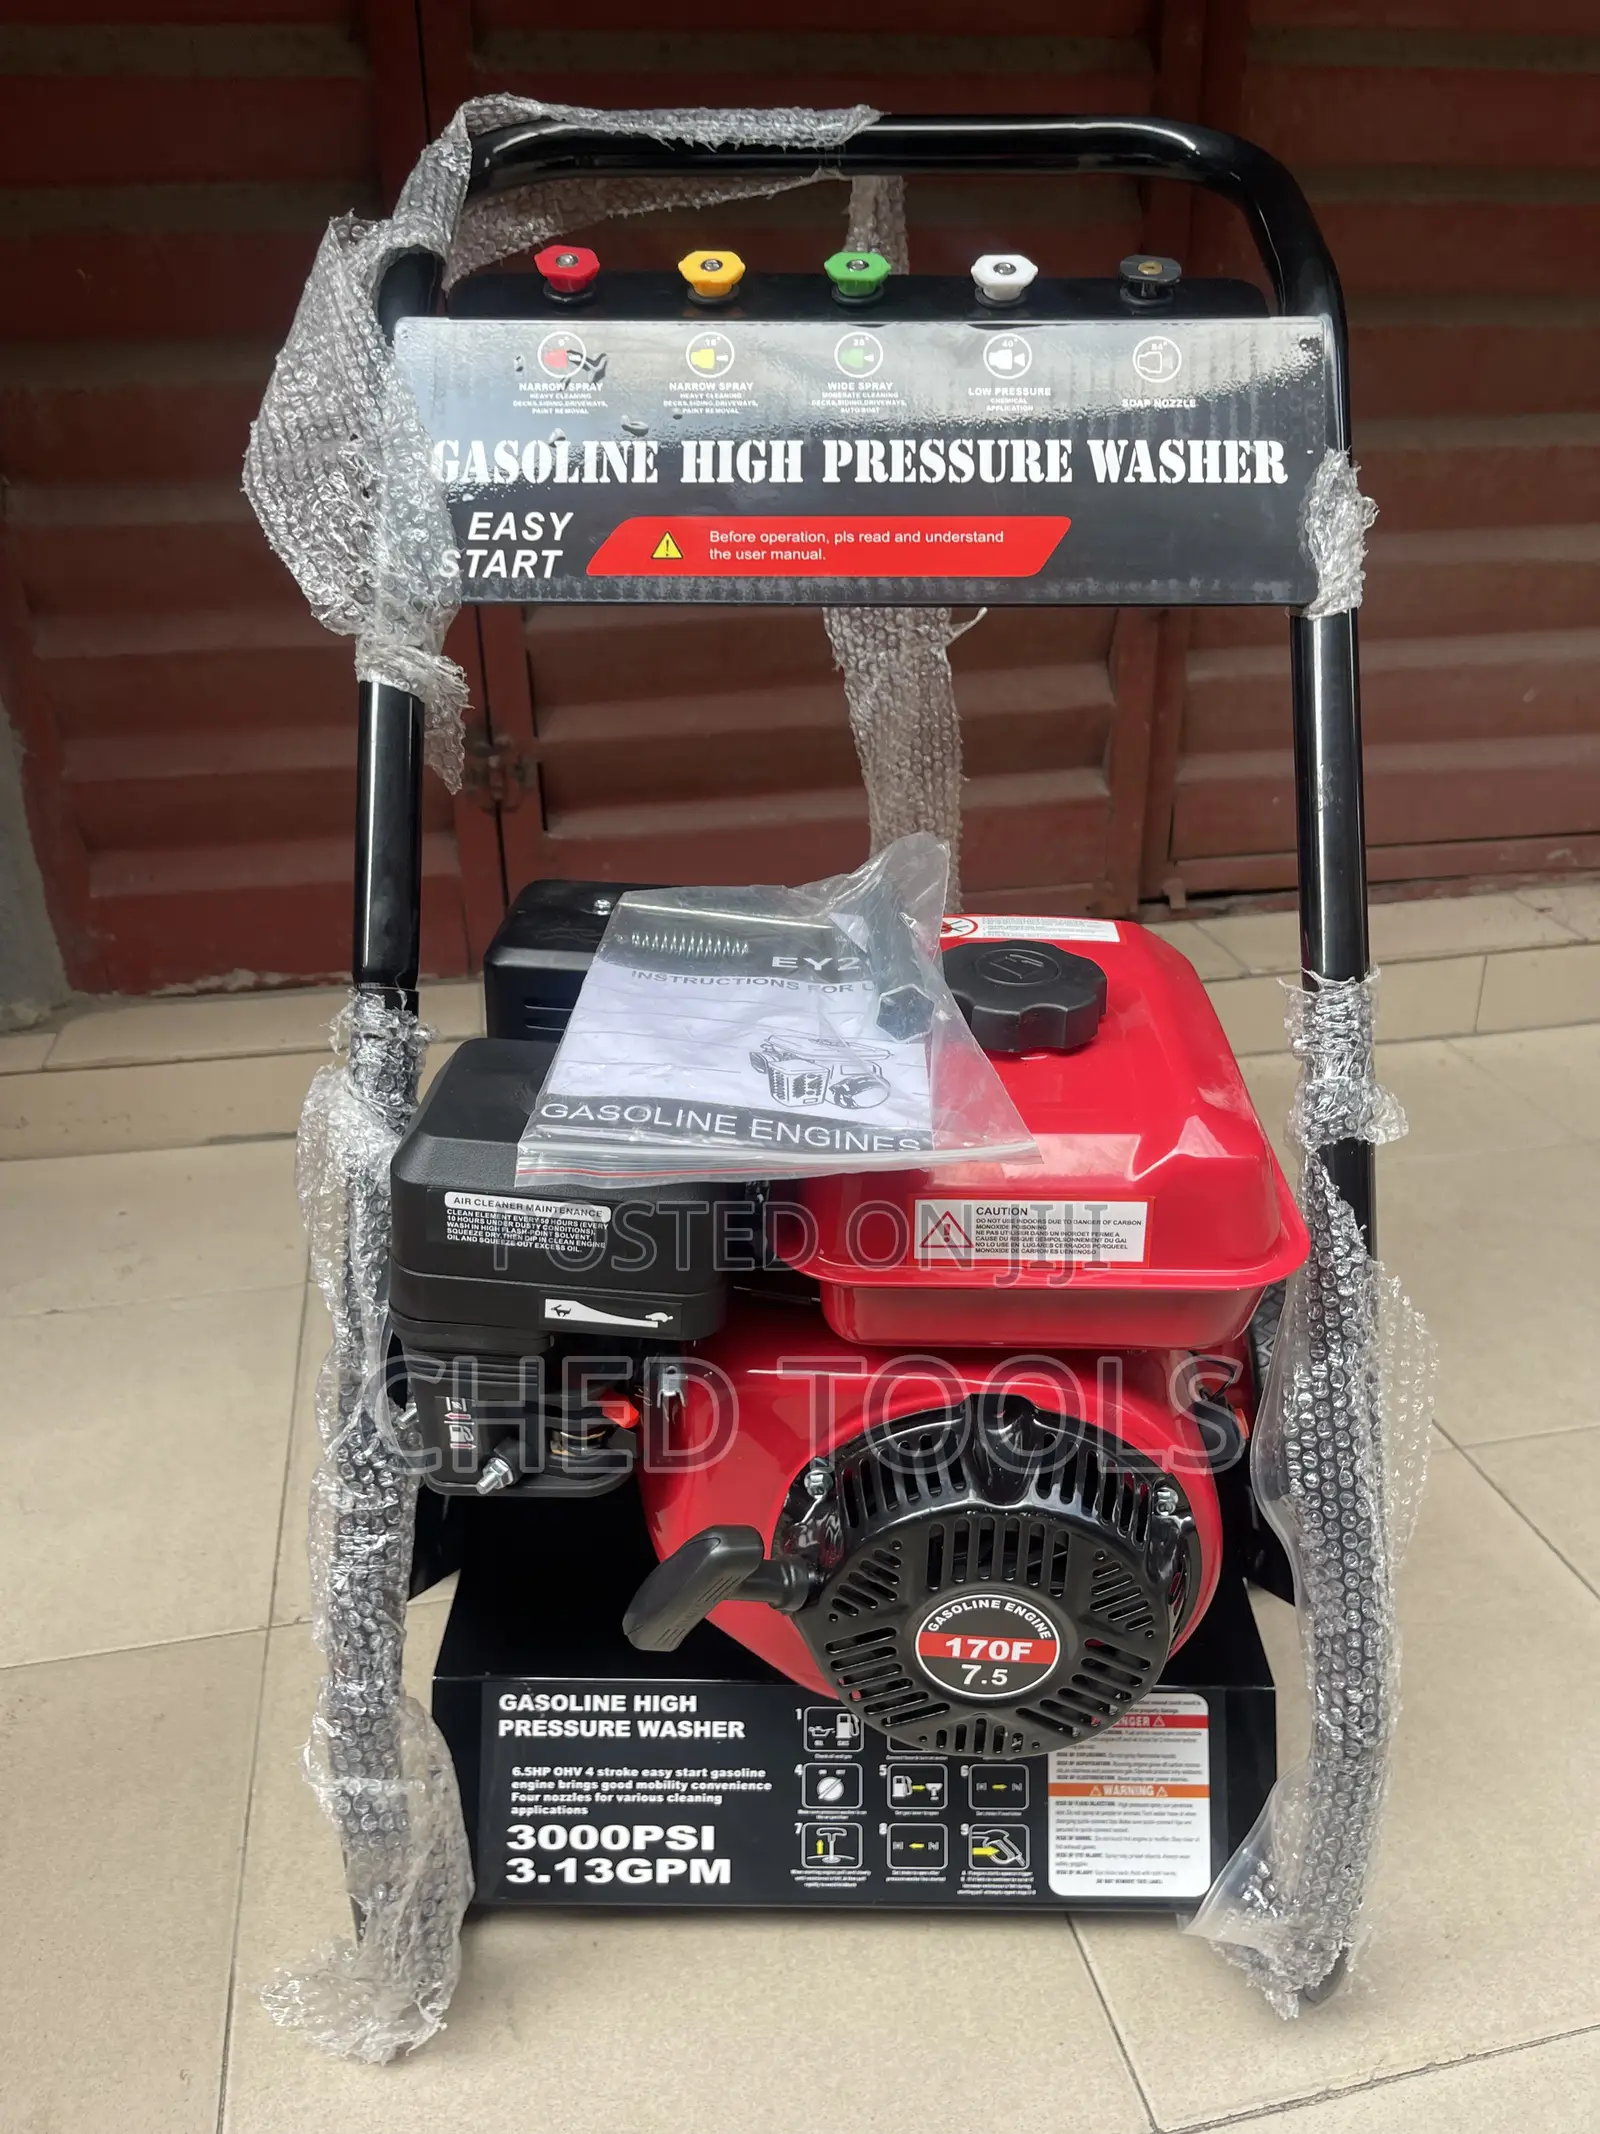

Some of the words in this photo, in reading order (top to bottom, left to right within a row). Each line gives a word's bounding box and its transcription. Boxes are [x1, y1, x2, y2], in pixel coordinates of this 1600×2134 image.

[519, 382, 566, 392] NARROW
[568, 382, 604, 392] SPRAY
[669, 382, 716, 392] NARROW
[718, 382, 754, 392] SPRAY
[827, 382, 856, 391] WIDE
[858, 382, 894, 391] SPRAY
[968, 387, 992, 396] LOW
[994, 387, 1052, 396] PRESSURE
[1122, 399, 1152, 408] SOAP
[1154, 399, 1196, 408] NOZZLE
[432, 440, 659, 484] GASOLINE
[680, 440, 804, 484] HIGH
[822, 439, 1073, 484] PRESSURE
[1086, 439, 1289, 484] WASHER
[467, 512, 575, 541] EASY
[709, 530, 756, 543] Before
[760, 530, 830, 546] operation,
[834, 530, 854, 546] pls
[858, 530, 890, 543] read
[894, 530, 921, 543] and
[925, 530, 1005, 544] understand
[709, 548, 732, 561] the
[735, 551, 767, 561] user
[770, 548, 827, 561] manual.
[439, 549, 564, 579] START
[632, 970, 800, 991] INSTRUCTIONS
[807, 983, 854, 994] FOR
[540, 1102, 738, 1136] GASOLINE
[750, 1117, 922, 1153] ENGINES
[453, 1197, 472, 1206] AIR
[474, 1198, 524, 1211] CLEANER
[526, 1204, 604, 1218] MAINTENANCE
[976, 1207, 1028, 1216] CAUTION
[446, 1208, 474, 1217] CLEAN
[475, 1212, 512, 1220] ELEMENT
[513, 1215, 539, 1223] EVERY
[550, 1219, 578, 1227] HOURS
[580, 1222, 608, 1230] (EVERY
[446, 1222, 470, 1230] WASH
[457, 1216, 486, 1224] HOURS
[486, 1219, 514, 1227] UNDER
[515, 1222, 544, 1230] DUSTY
[446, 1228, 484, 1237] SQUEEZE
[548, 1238, 575, 1246] CLEAN
[576, 1240, 606, 1248] ENGINE
[479, 1237, 516, 1246] SQUEEZE
[535, 1242, 566, 1251] EXCESS
[927, 1598, 1002, 1633] GASOLINE
[1004, 1602, 1052, 1640] ENGINE
[945, 1637, 1034, 1662] 170F
[960, 1663, 1009, 1686] 7.5
[498, 1694, 628, 1712] GASOLINE
[633, 1694, 698, 1713] HIGH
[795, 1708, 802, 1721] 1
[1116, 1716, 1150, 1726] NGER
[498, 1719, 632, 1738] PRESSURE
[636, 1720, 746, 1740] WASHER
[511, 1766, 552, 1778] 6.5HP
[554, 1766, 584, 1778] OHV
[584, 1767, 596, 1778] 4
[596, 1766, 639, 1778] stroke
[642, 1769, 673, 1781] easy
[674, 1768, 708, 1779] start
[710, 1768, 766, 1782] gasoline
[960, 1765, 970, 1777] 6
[511, 1780, 556, 1792] engine
[558, 1780, 599, 1793] brings
[601, 1780, 634, 1793] good
[636, 1780, 688, 1794] mobility
[690, 1780, 773, 1792] convenience
[1103, 1785, 1154, 1796] WARNING
[511, 1792, 541, 1802] Four
[543, 1792, 592, 1803] nozzles
[594, 1792, 614, 1803] for
[616, 1792, 664, 1804] various
[666, 1793, 722, 1805] cleaning
[510, 1804, 590, 1817] applications
[794, 1823, 802, 1834] 7
[506, 1824, 716, 1852] 3000PSI
[506, 1857, 732, 1885] 3.13GPM
